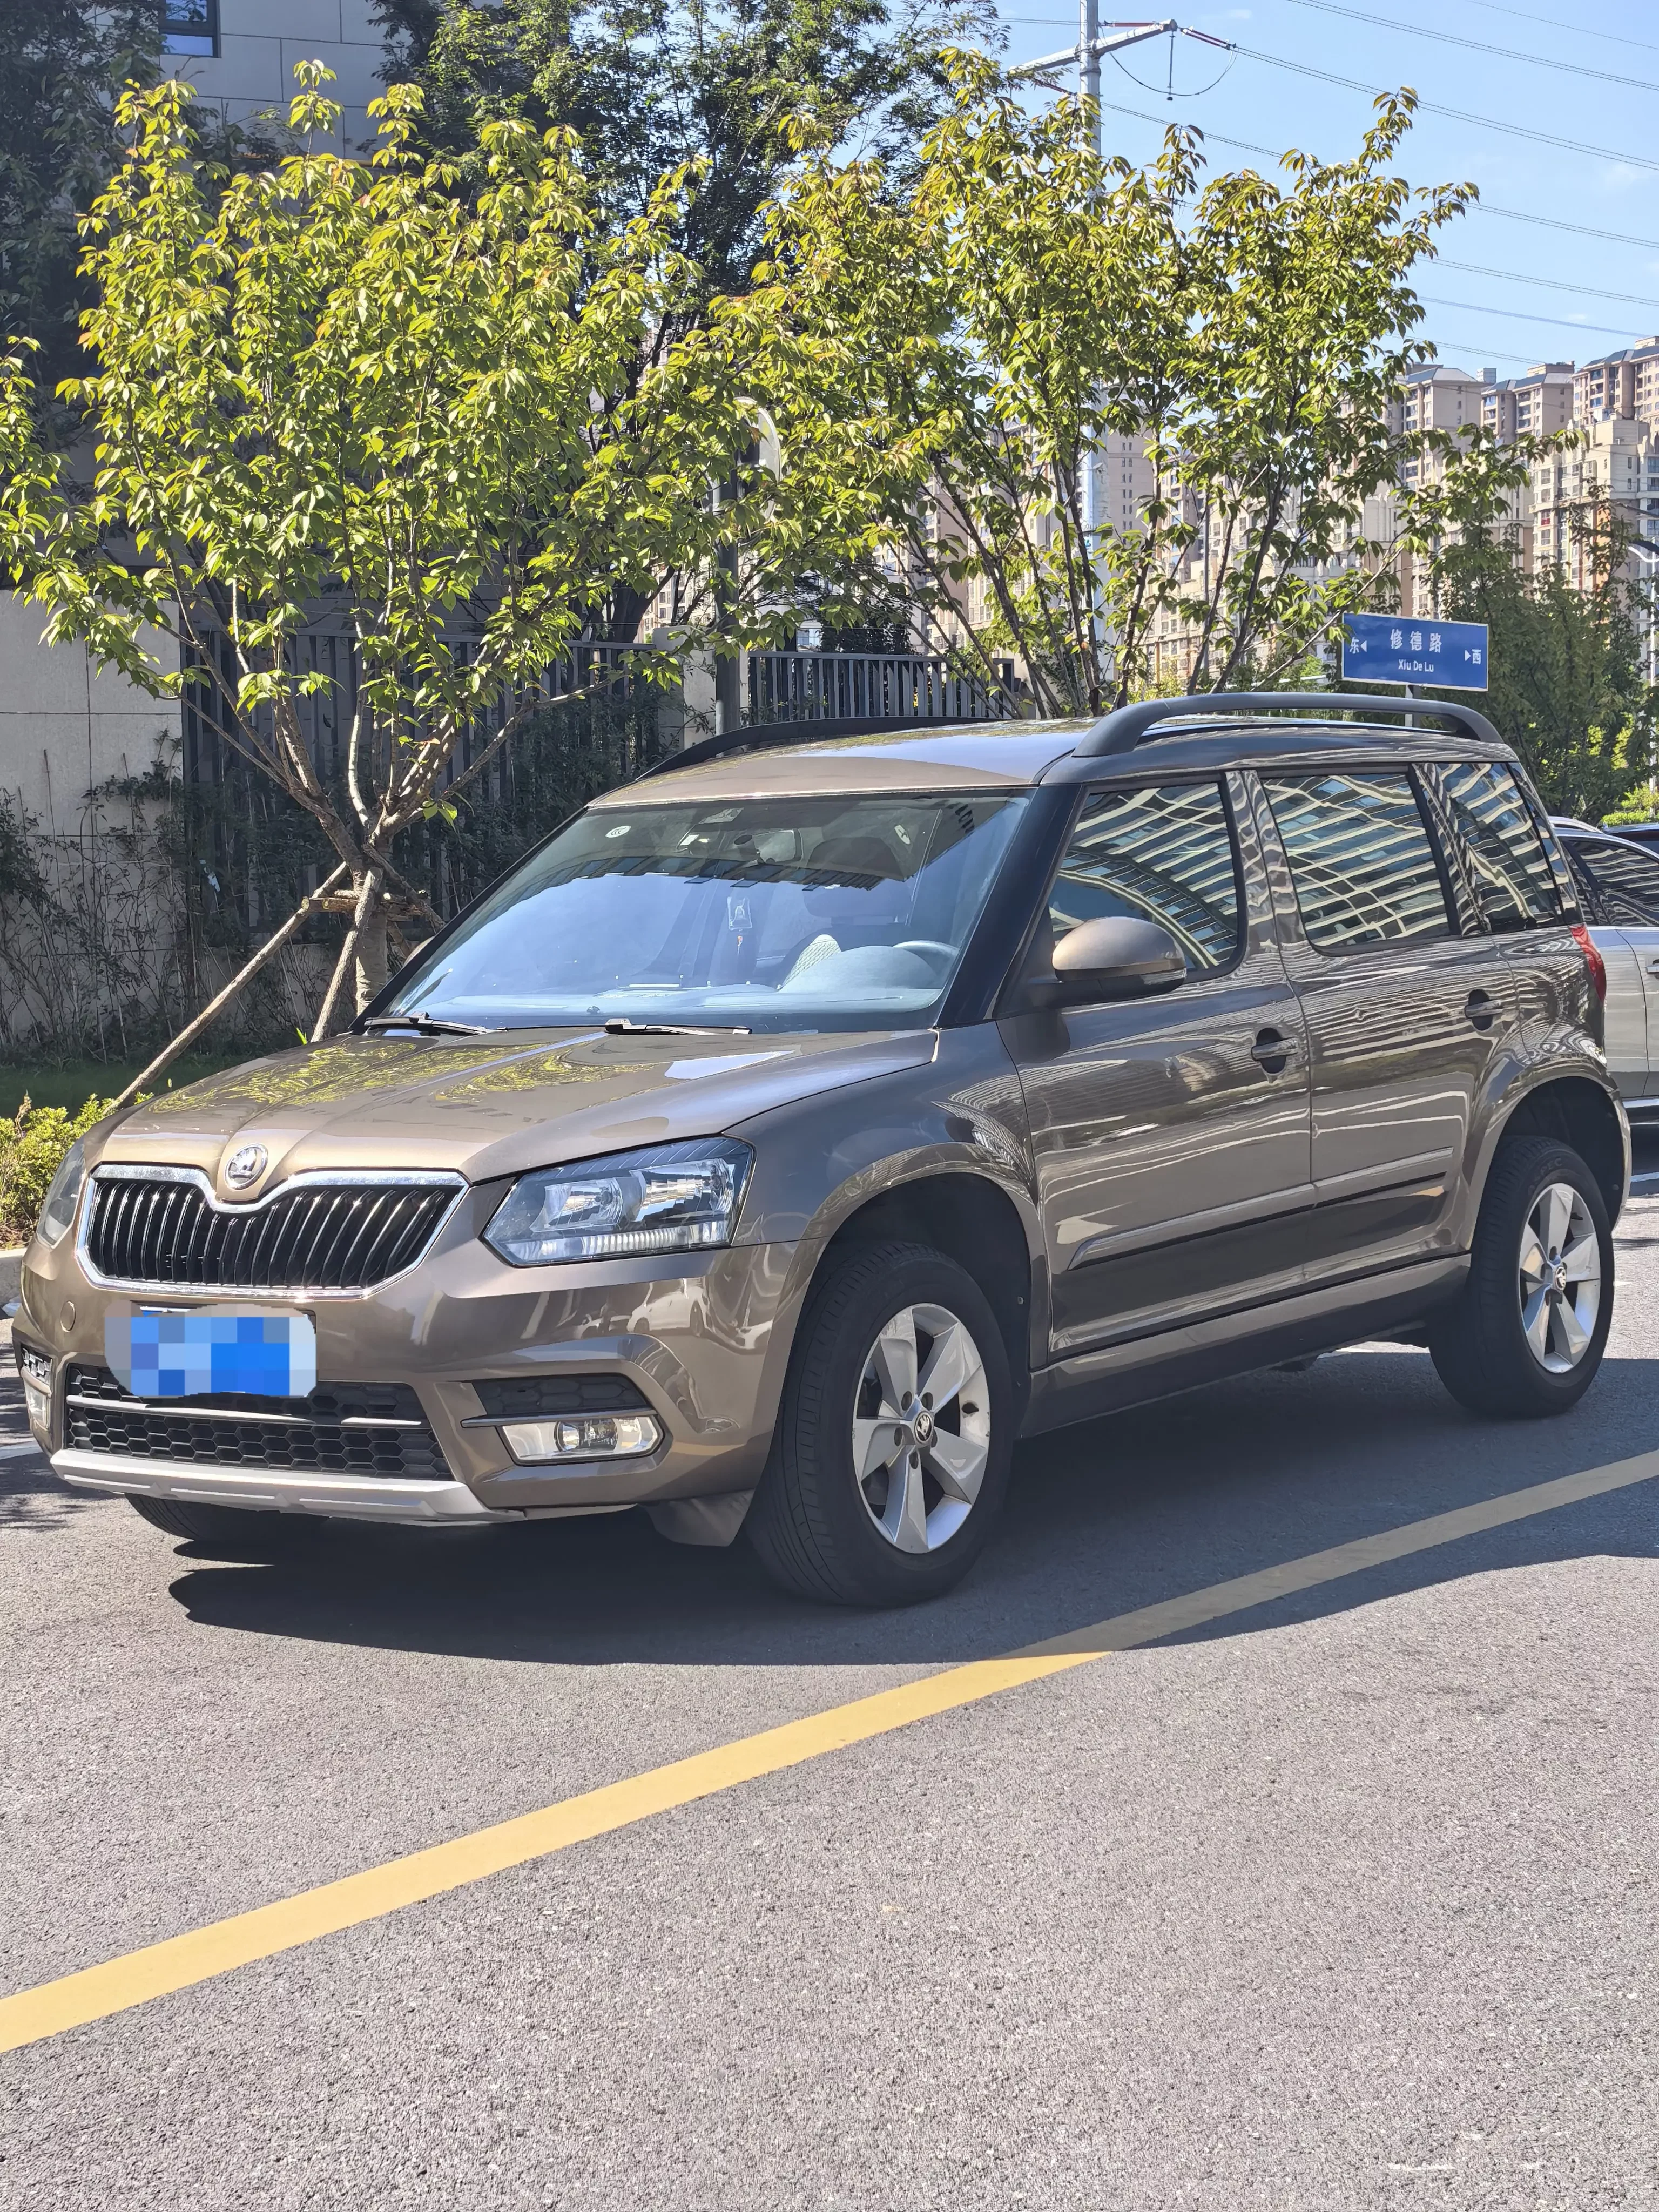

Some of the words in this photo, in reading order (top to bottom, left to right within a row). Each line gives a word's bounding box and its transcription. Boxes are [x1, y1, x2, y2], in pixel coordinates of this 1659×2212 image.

[1349, 636, 1360, 654] 东
[1390, 628, 1442, 653] 修德路
[1398, 659, 1411, 671] Xiu
[1413, 660, 1423, 671] De
[1424, 661, 1434, 672] Lu
[1471, 649, 1482, 665] 西
